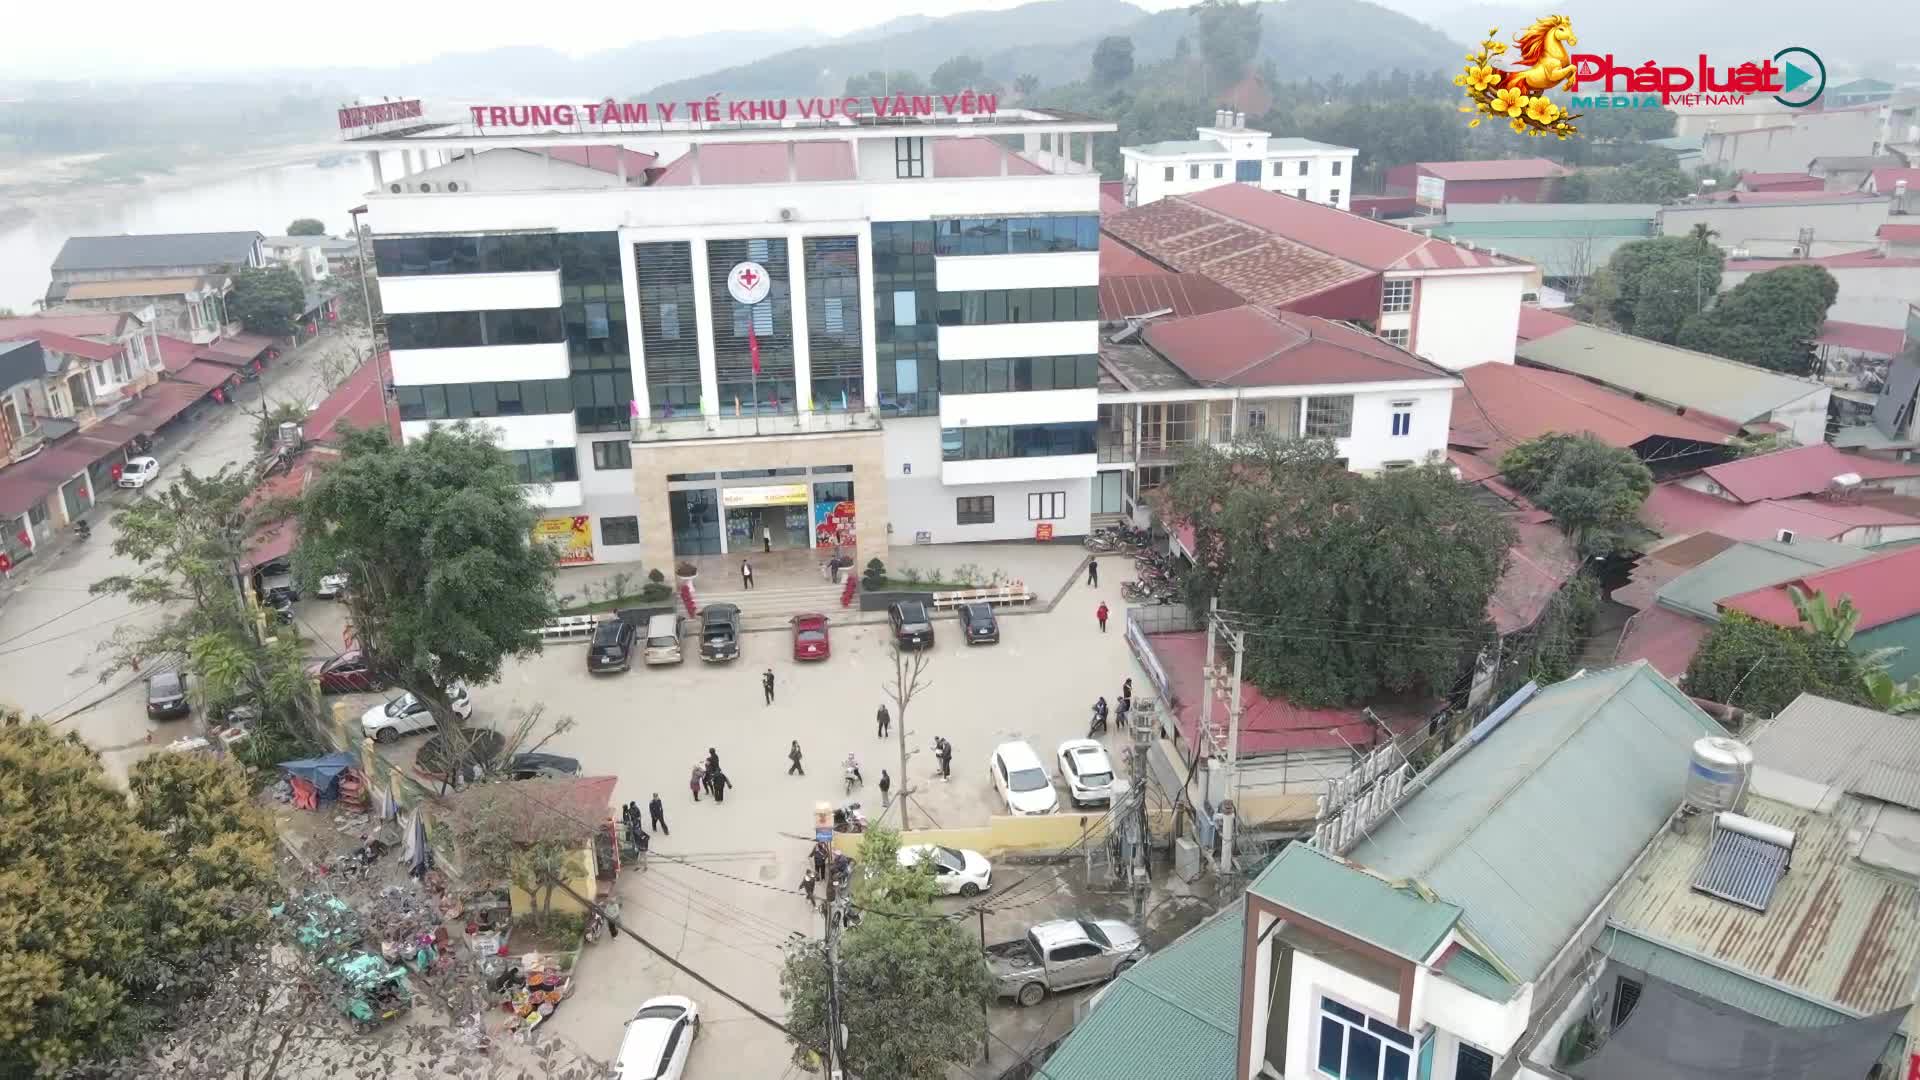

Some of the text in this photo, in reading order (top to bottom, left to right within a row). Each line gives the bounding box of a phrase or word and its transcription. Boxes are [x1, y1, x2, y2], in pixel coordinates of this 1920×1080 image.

[471, 104, 575, 126] TRUNG
[584, 98, 648, 124] TÂM
[658, 102, 678, 122] Y
[687, 92, 722, 121] TẾ
[729, 100, 787, 121] KHU
[871, 92, 932, 116] VĂN
[941, 89, 997, 115] YÊN
